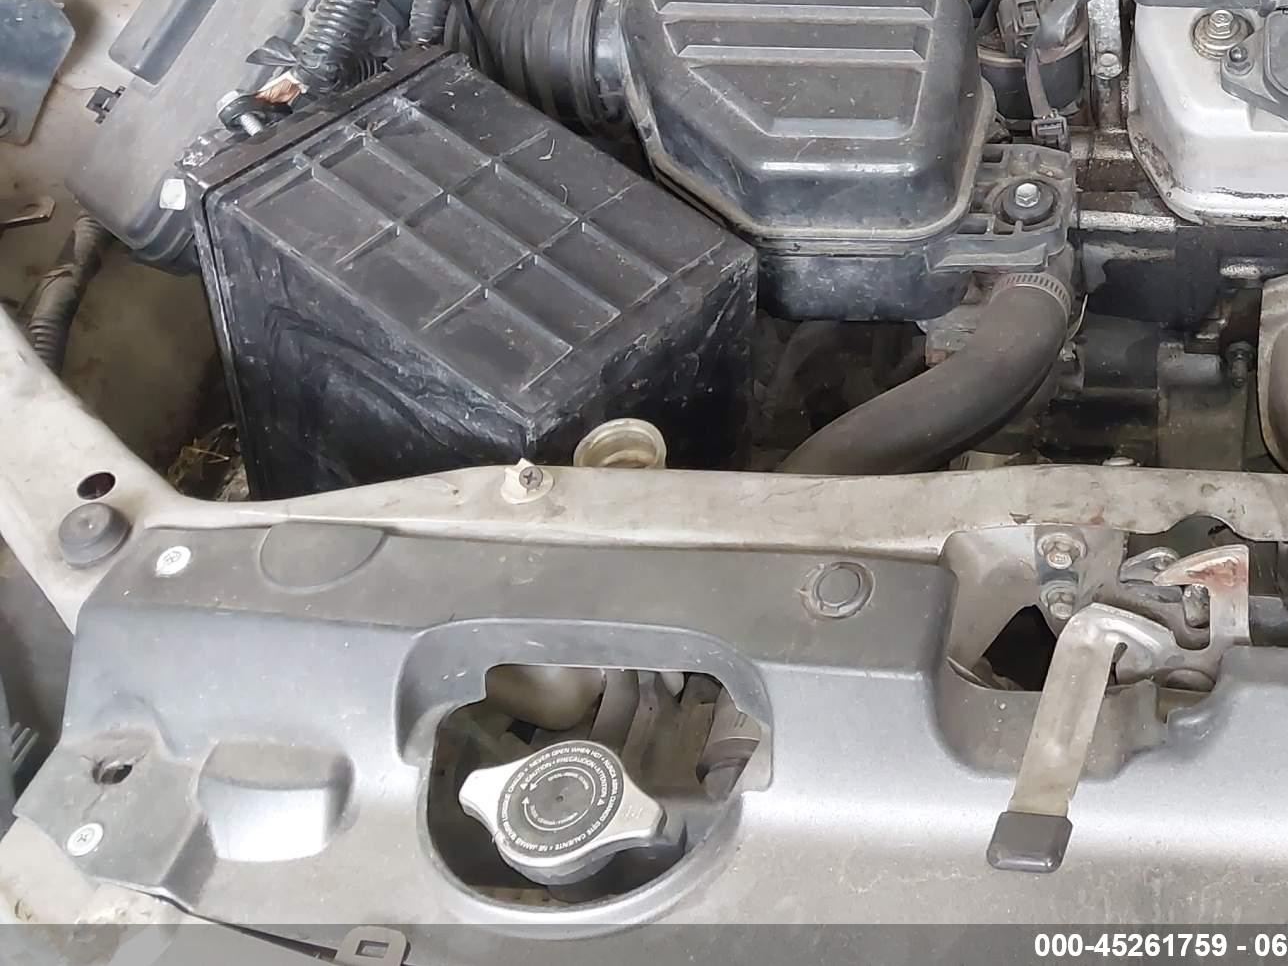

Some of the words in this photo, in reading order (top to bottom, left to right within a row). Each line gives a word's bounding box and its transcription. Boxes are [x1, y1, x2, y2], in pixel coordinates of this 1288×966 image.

[529, 752, 551, 768] NEVER
[551, 747, 570, 757] OPEN
[570, 747, 591, 755] WHEN
[590, 750, 602, 759] HOT
[525, 762, 551, 784] CAUTION
